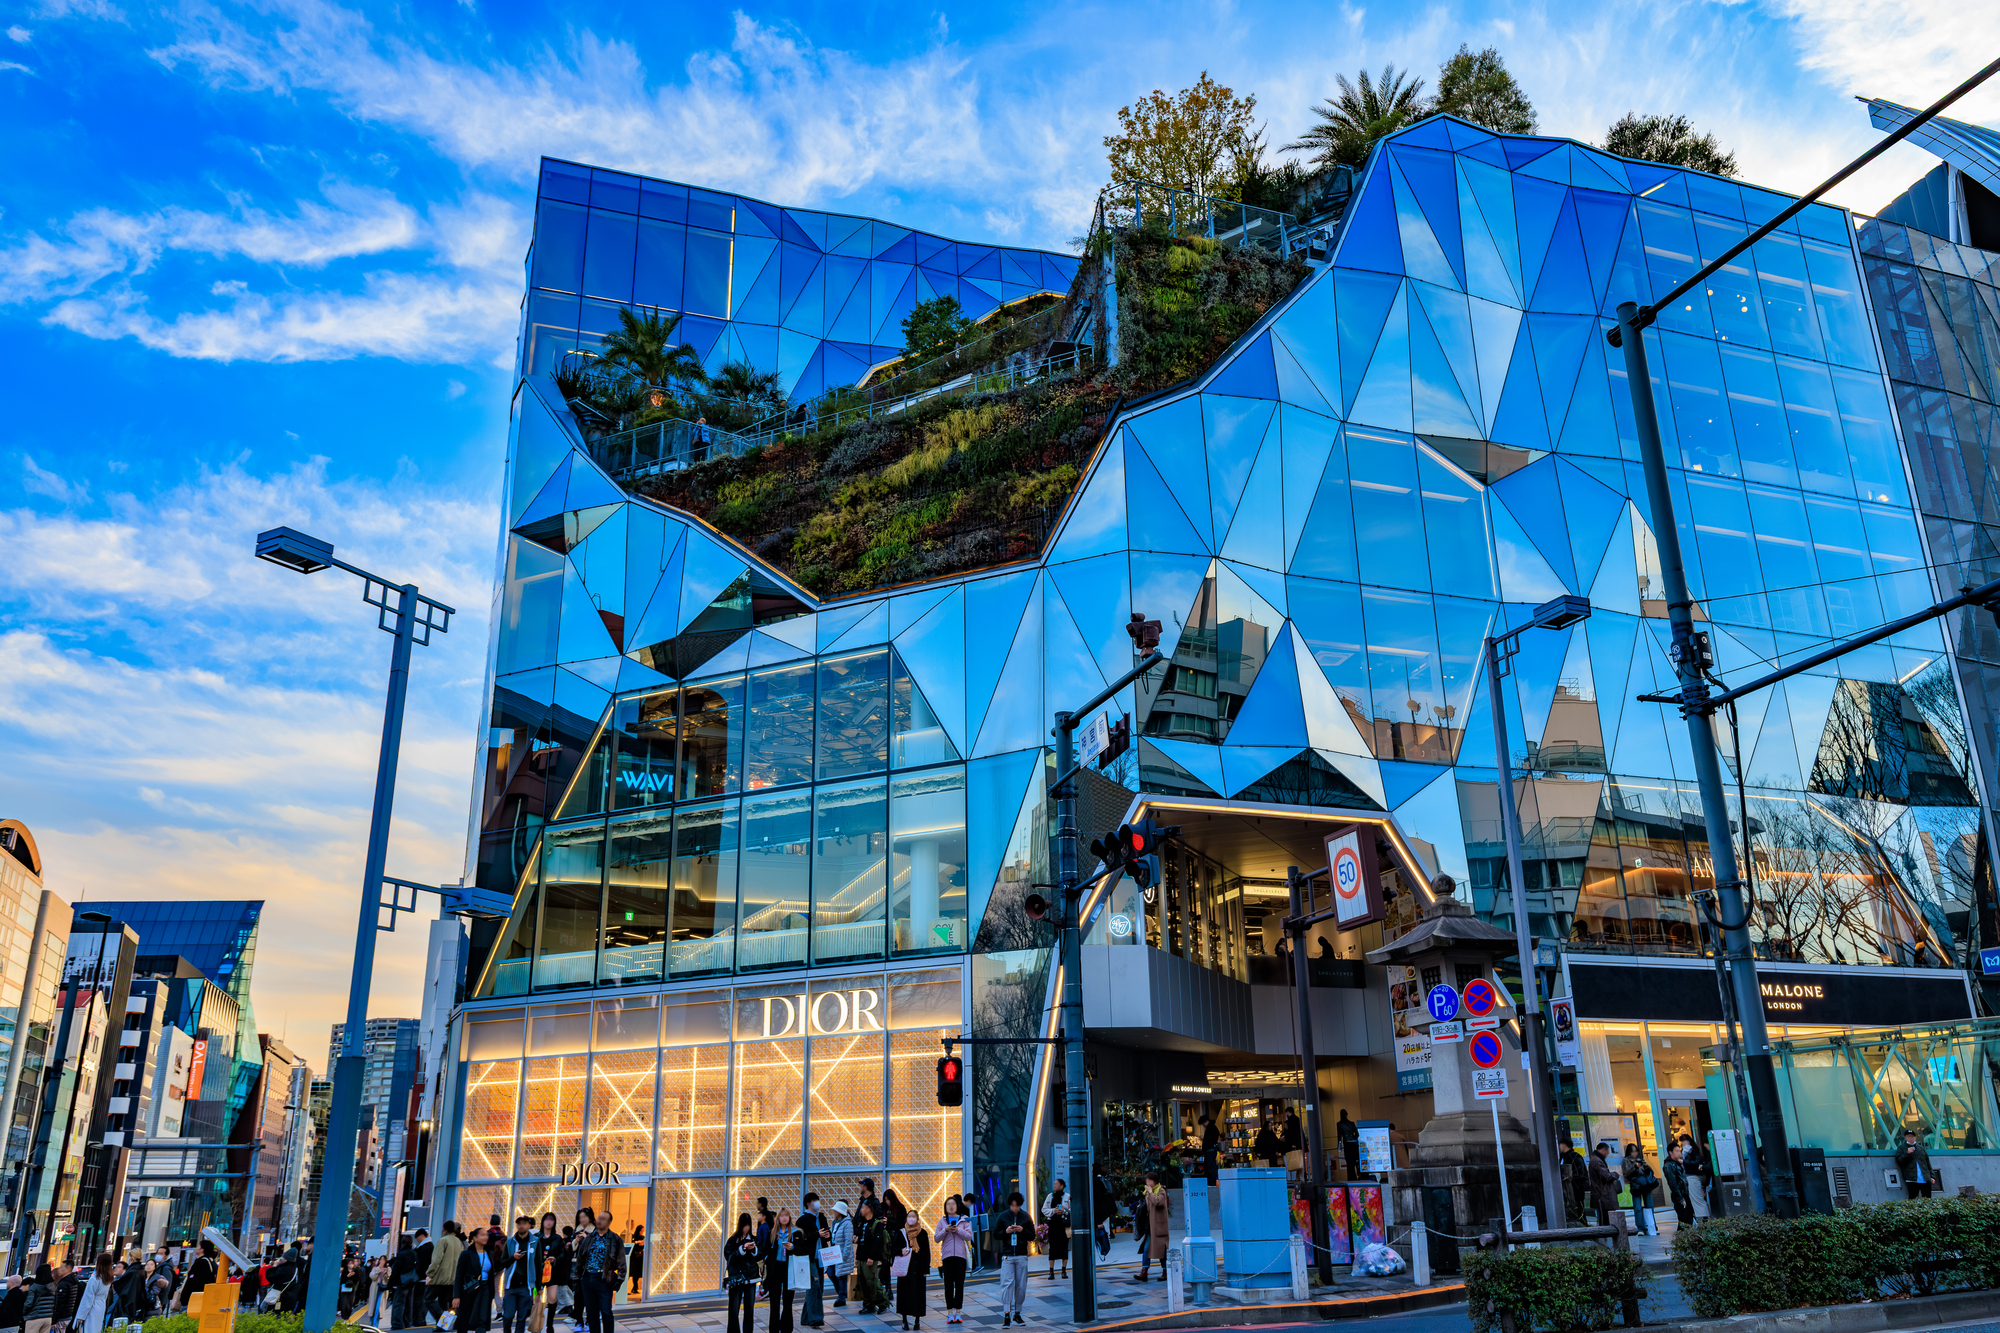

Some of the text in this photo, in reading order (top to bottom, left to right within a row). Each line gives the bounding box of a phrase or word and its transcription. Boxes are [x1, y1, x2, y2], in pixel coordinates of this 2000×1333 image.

[1338, 861, 1355, 885] 50
[1760, 983, 1824, 998] MALONE
[760, 989, 885, 1038] DIOR
[1433, 993, 1453, 1017] P 60
[1767, 1001, 1802, 1010] LONDON
[1401, 1073, 1425, 1086] 営業時間
[1476, 1072, 1486, 1080] 20
[1496, 1070, 1501, 1078] 9
[560, 1161, 622, 1187] DIOR
